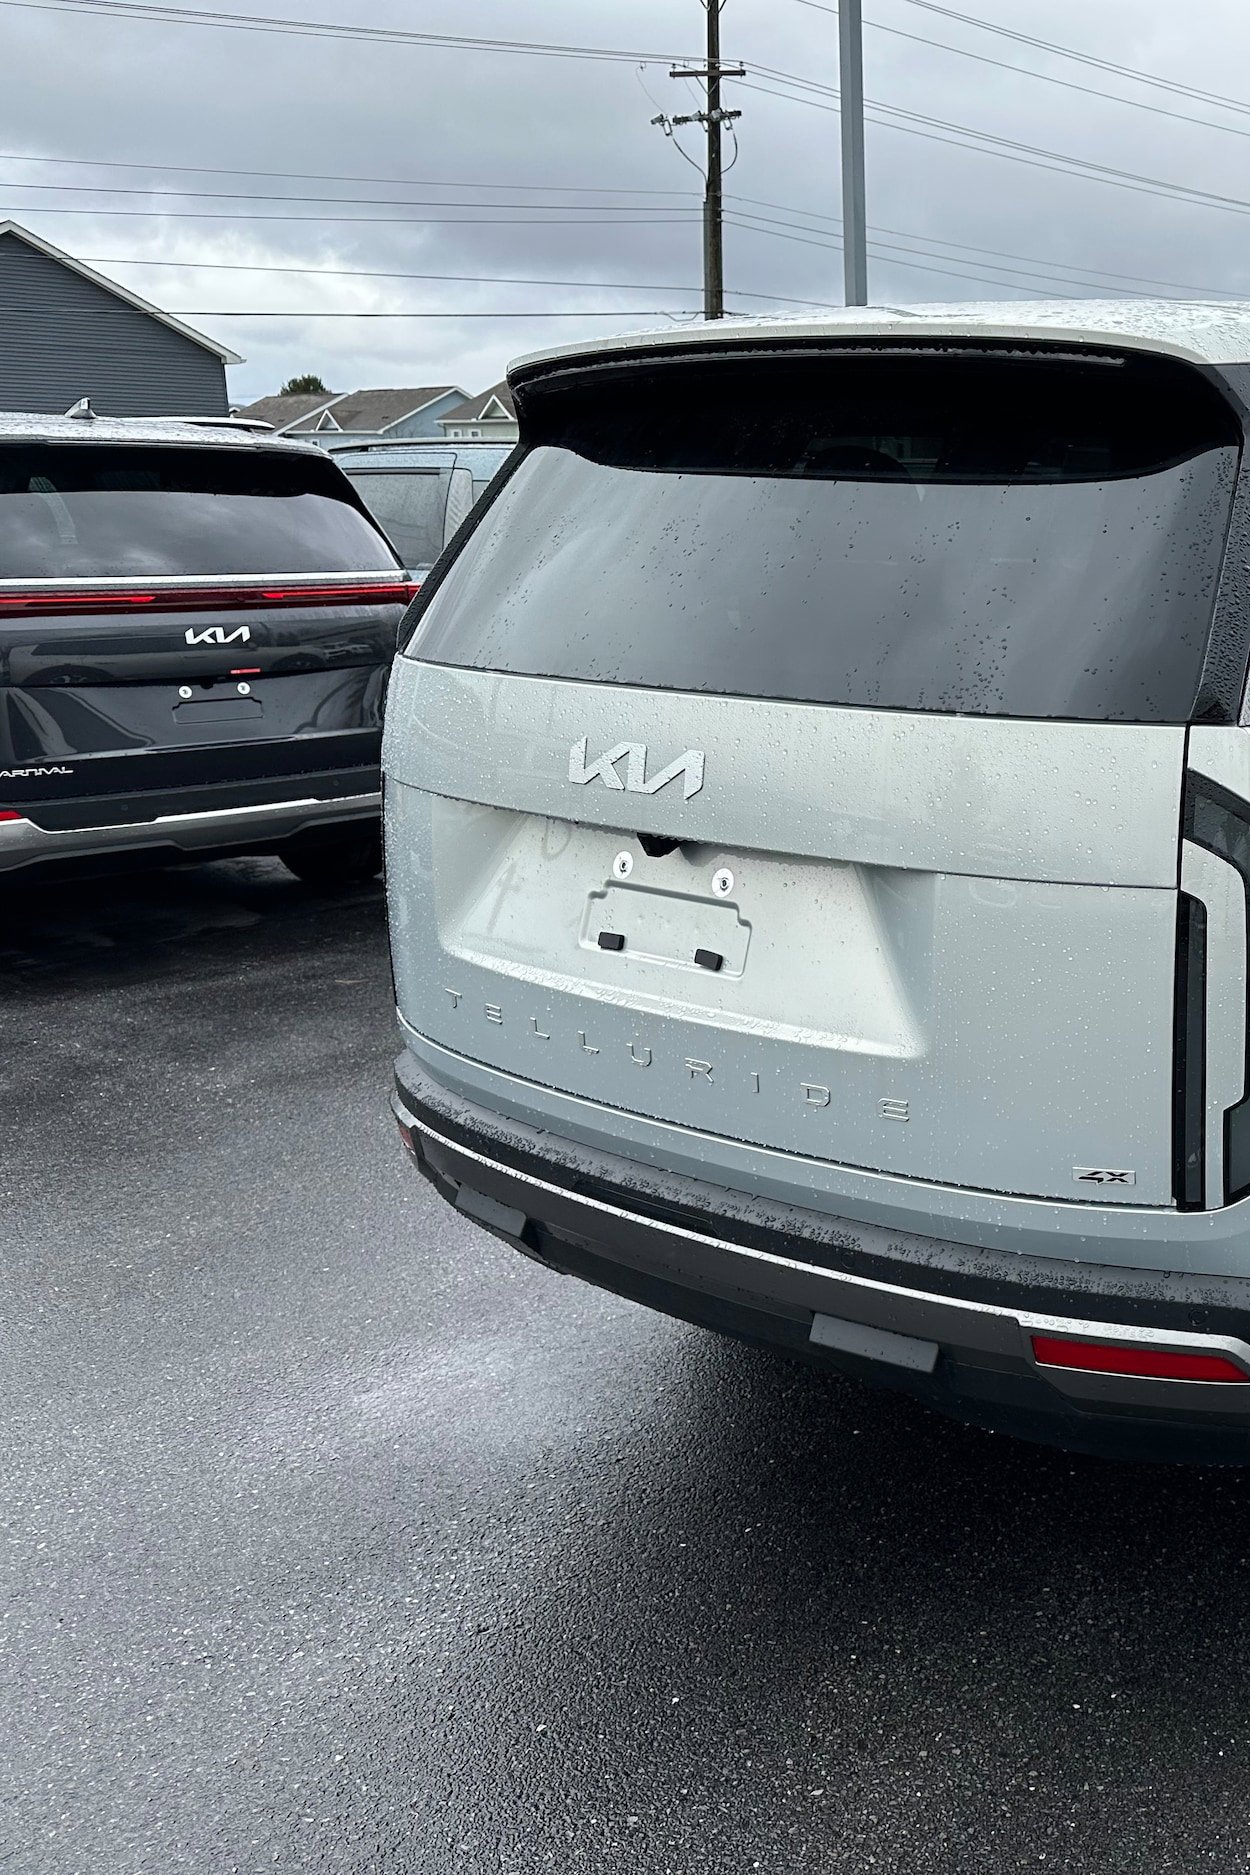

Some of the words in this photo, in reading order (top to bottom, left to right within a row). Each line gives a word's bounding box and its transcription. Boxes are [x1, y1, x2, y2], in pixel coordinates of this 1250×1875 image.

[184, 625, 251, 645] KIA
[0, 766, 74, 778] ARNIVAL
[568, 736, 706, 800] KIA
[444, 987, 910, 1123] TELLURIDE
